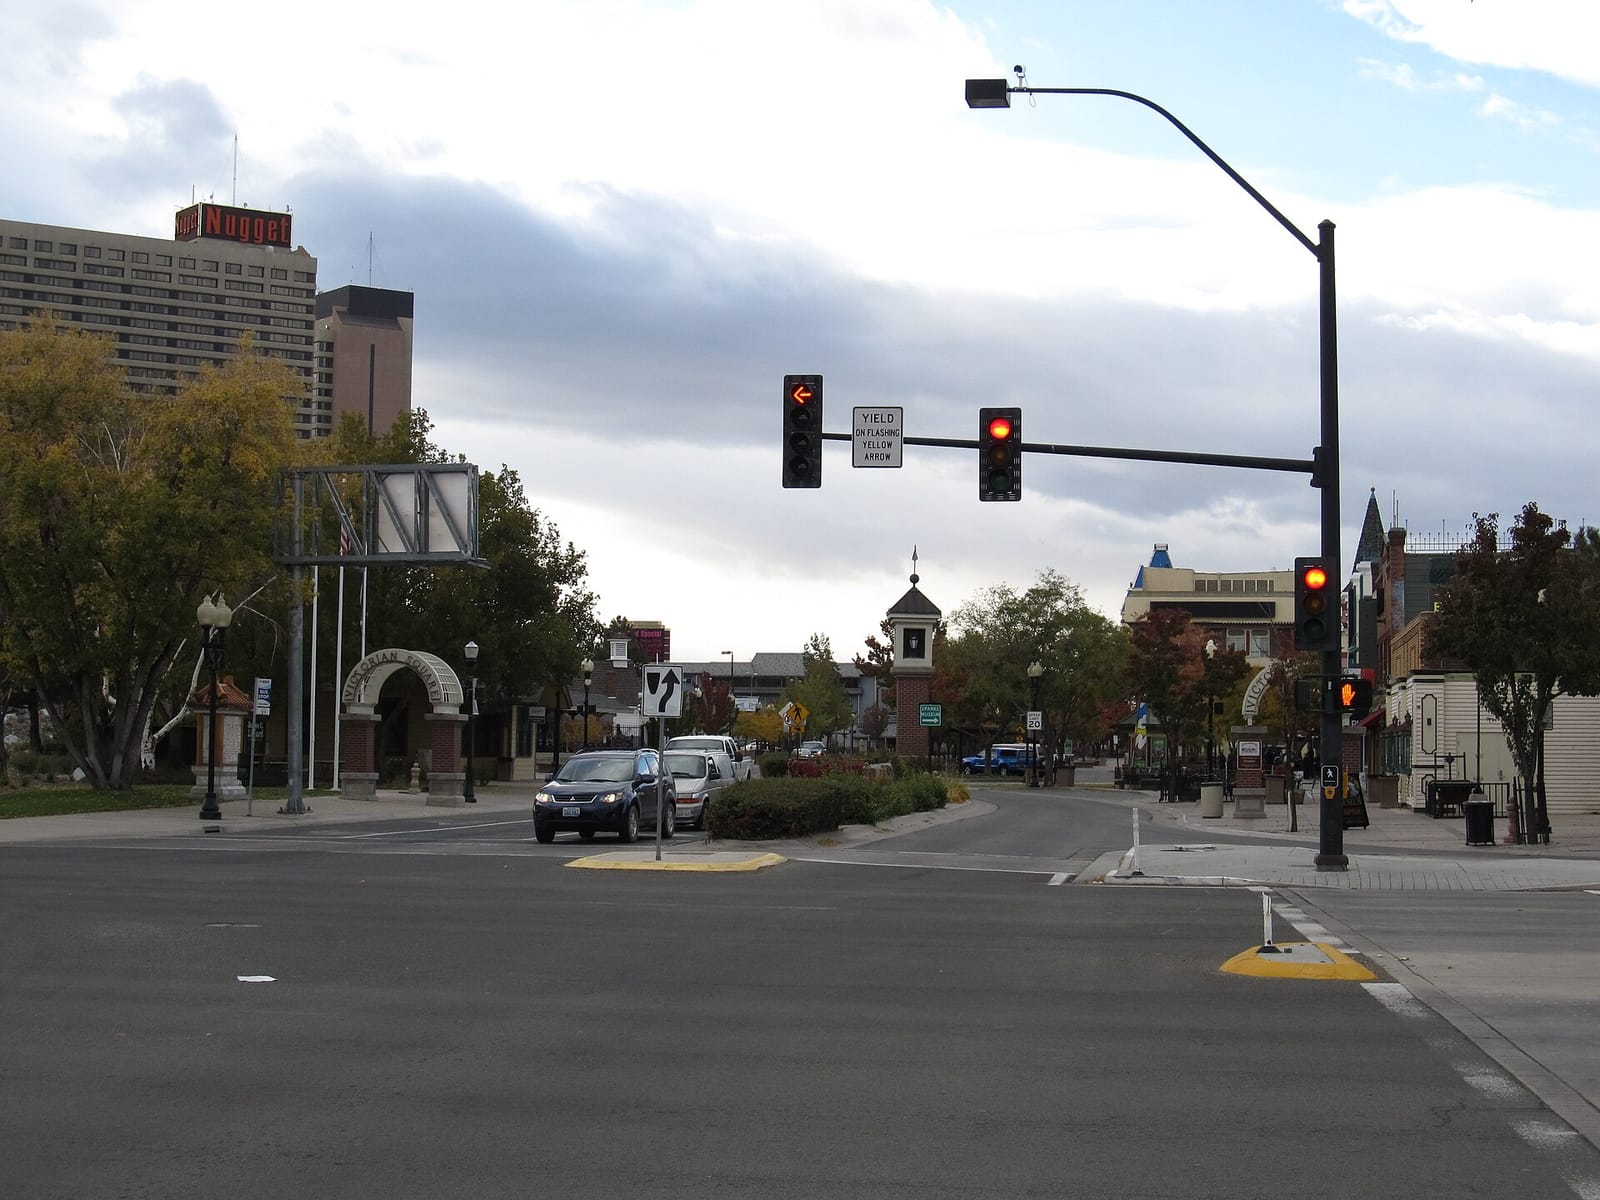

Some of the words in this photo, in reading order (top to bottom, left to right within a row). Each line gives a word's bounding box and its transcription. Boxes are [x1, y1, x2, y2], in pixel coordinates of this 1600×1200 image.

[206, 206, 289, 243] Nugget
[862, 413, 894, 423] YIELD
[855, 428, 866, 437] ON
[867, 428, 900, 437] FLASHING
[862, 440, 893, 449] YELLOW
[864, 452, 891, 461] ARROW
[344, 652, 398, 698] VICTORIAN
[407, 655, 440, 700] SQUARE
[1028, 720, 1041, 728] 20
